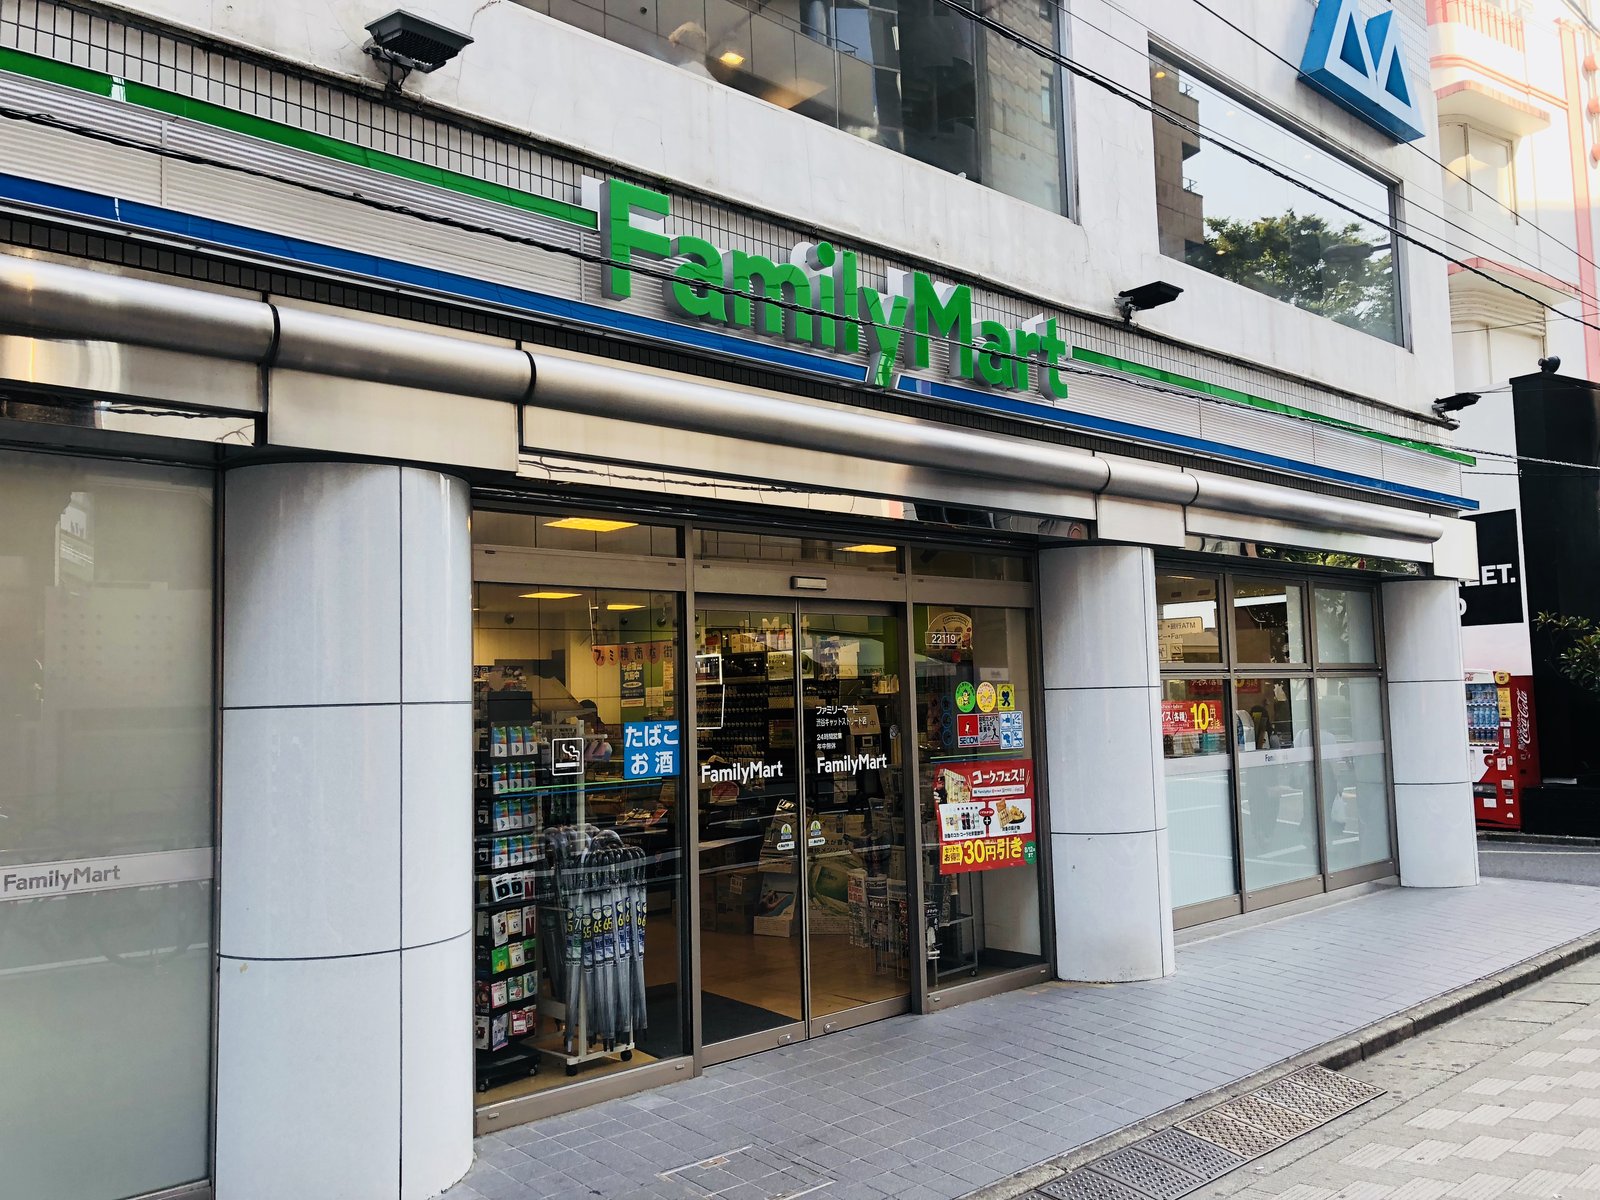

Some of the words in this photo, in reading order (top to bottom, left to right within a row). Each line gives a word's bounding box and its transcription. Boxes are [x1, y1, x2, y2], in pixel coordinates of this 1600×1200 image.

[600, 177, 1068, 400] FamilyMart
[1459, 563, 1516, 587] ET.
[931, 633, 956, 644] 22119
[815, 705, 859, 715] ファミリーマート
[625, 724, 679, 748] たばこ
[959, 736, 978, 745] SECOM
[630, 751, 673, 775] お酒
[701, 760, 783, 784] FamilyMart
[817, 753, 888, 775] FamilyMart
[963, 836, 1023, 865] 30円引き
[3, 865, 121, 891] FamilyMart
